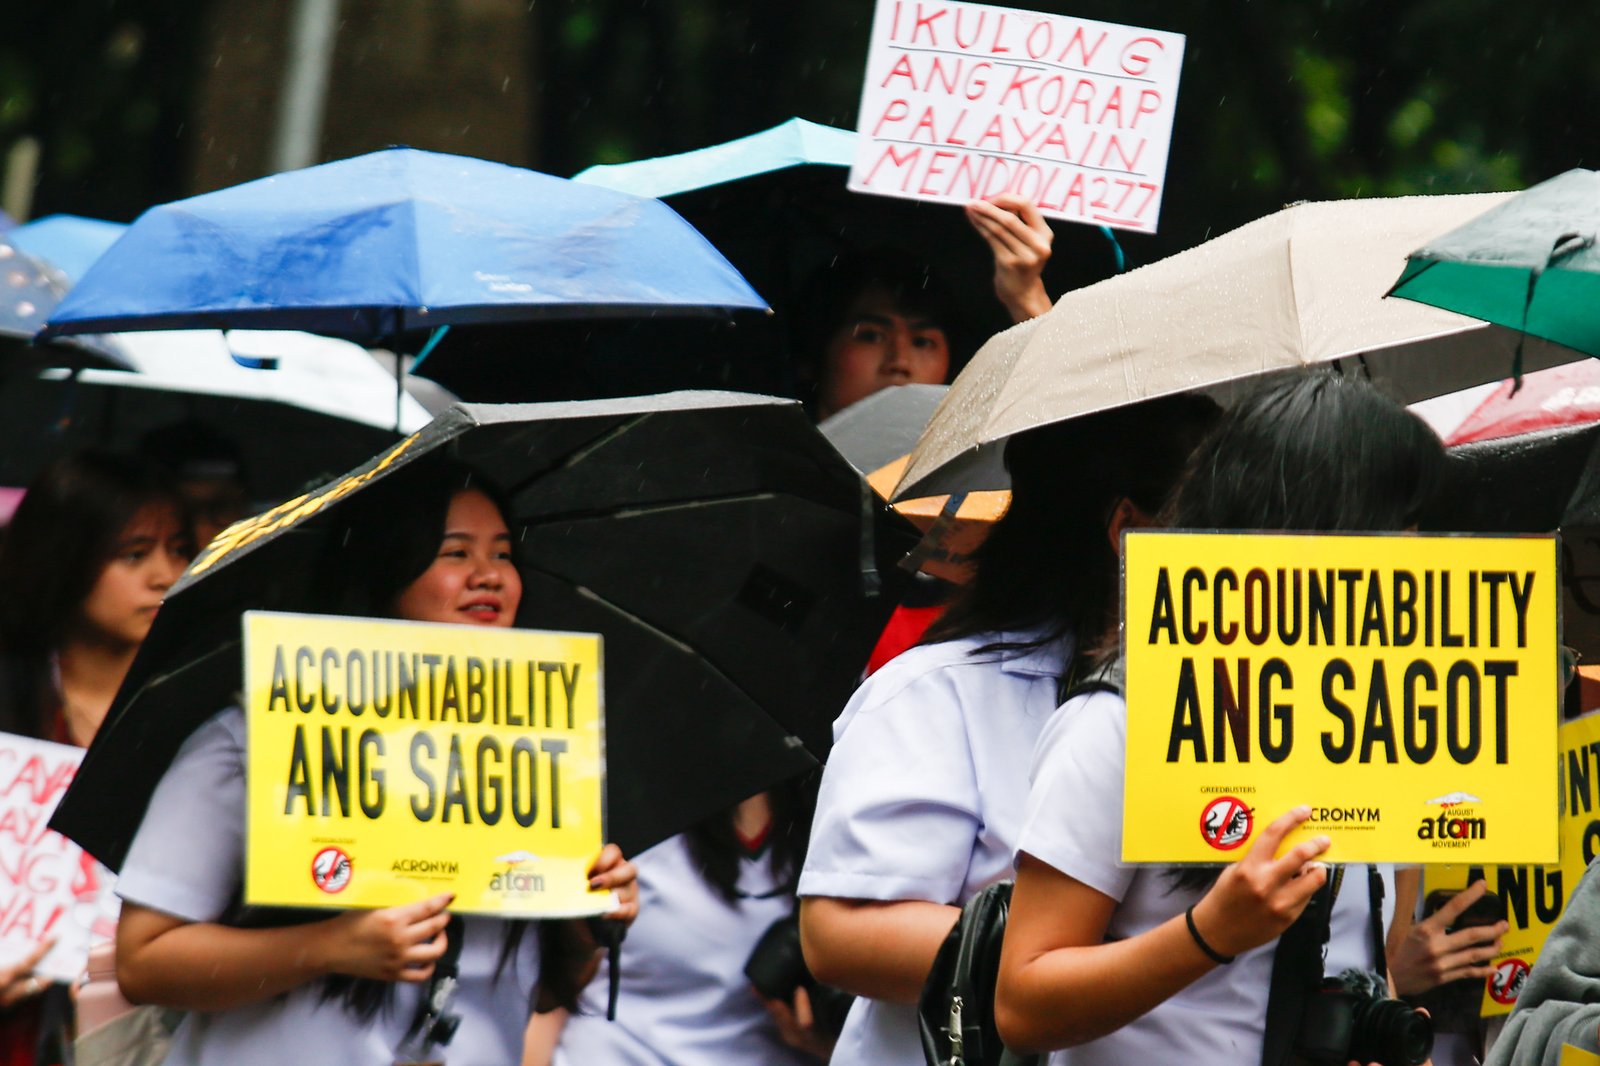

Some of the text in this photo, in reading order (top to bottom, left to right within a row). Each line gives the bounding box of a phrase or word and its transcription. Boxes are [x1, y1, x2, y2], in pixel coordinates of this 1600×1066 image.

[891, 2, 1165, 76] IKULONG
[881, 54, 1161, 129] ANG KORAP
[872, 99, 1147, 172] PALAYAIN
[1148, 566, 1536, 648] ACCOUNTABILITY
[268, 644, 581, 729] ACCOUNTABILITY
[1165, 657, 1519, 765] ANG SAGOT
[284, 723, 569, 829] ANG SAGOT
[1200, 786, 1256, 794] GREEDBUSTERS
[1307, 808, 1380, 822] CRONYM
[391, 859, 459, 874] ACRONYM
